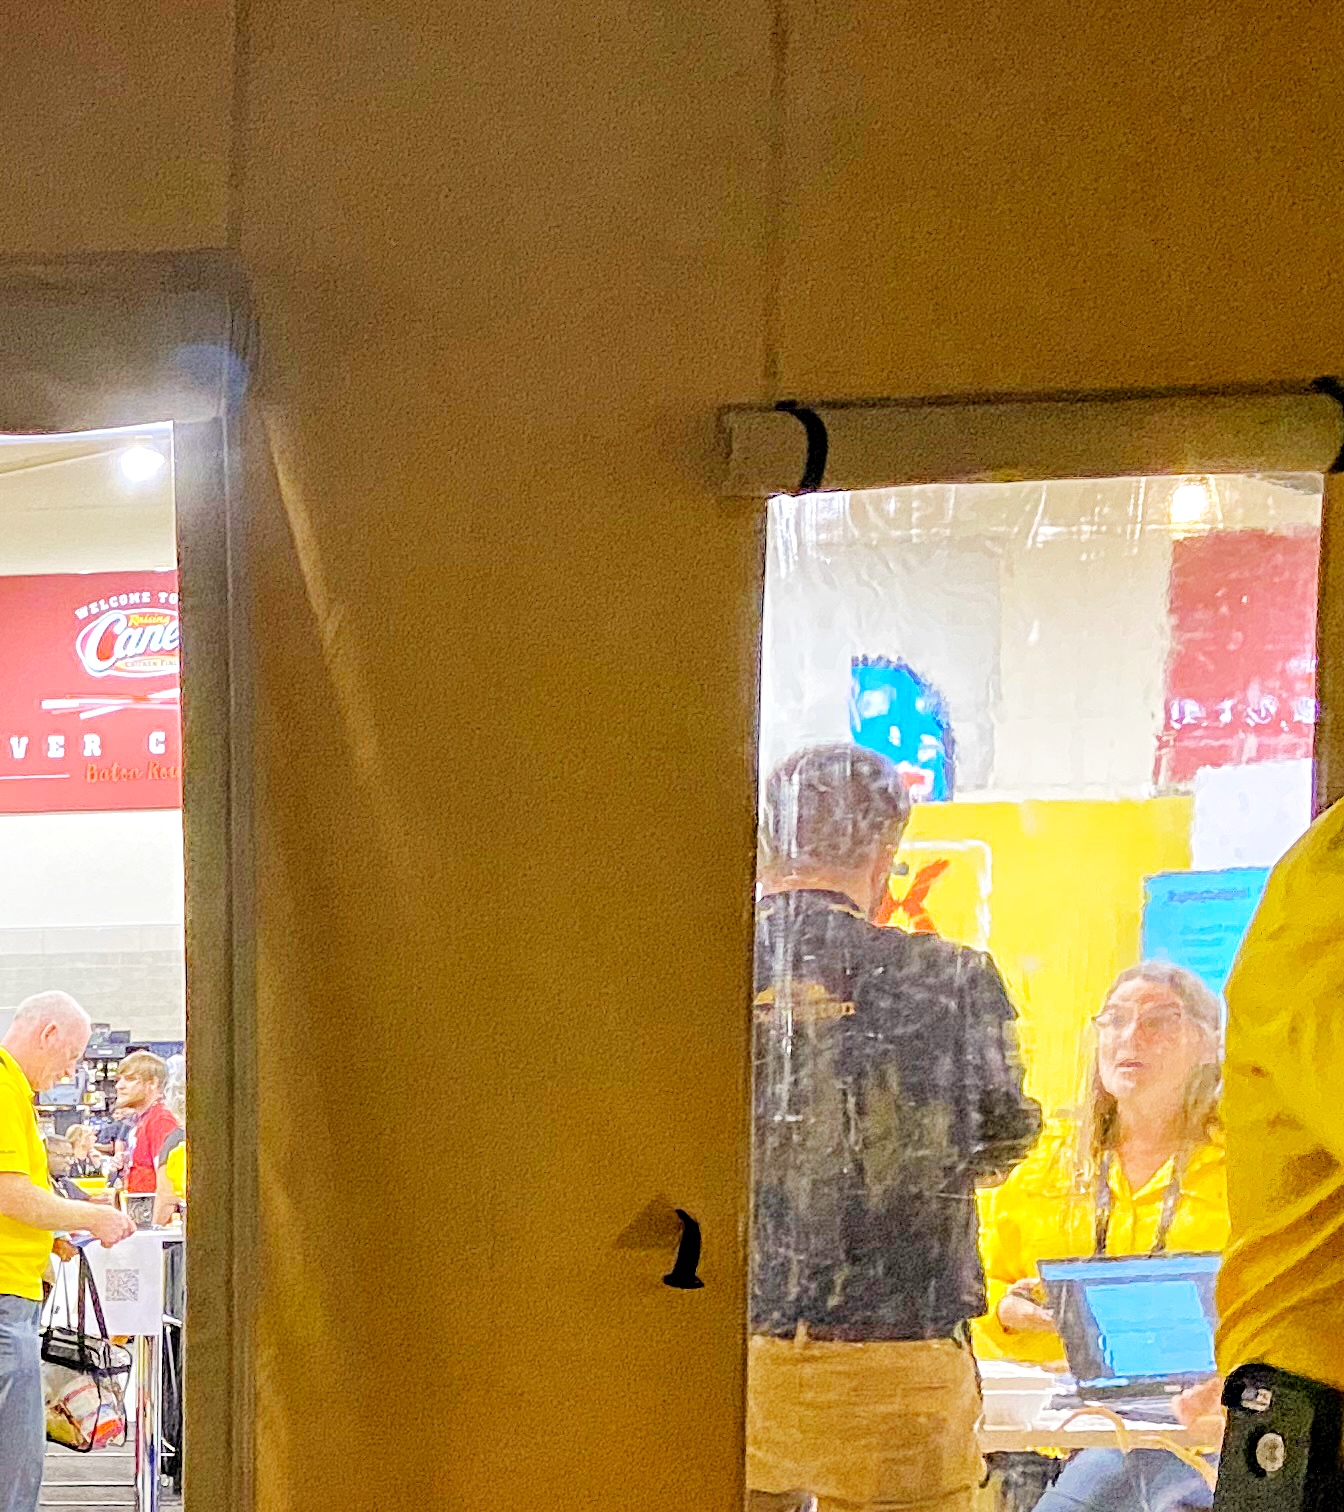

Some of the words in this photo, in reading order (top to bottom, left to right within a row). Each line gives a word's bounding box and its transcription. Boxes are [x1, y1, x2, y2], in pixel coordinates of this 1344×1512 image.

[75, 592, 151, 620] WELCOME
[158, 592, 179, 605] TO
[86, 763, 144, 783] Baton
